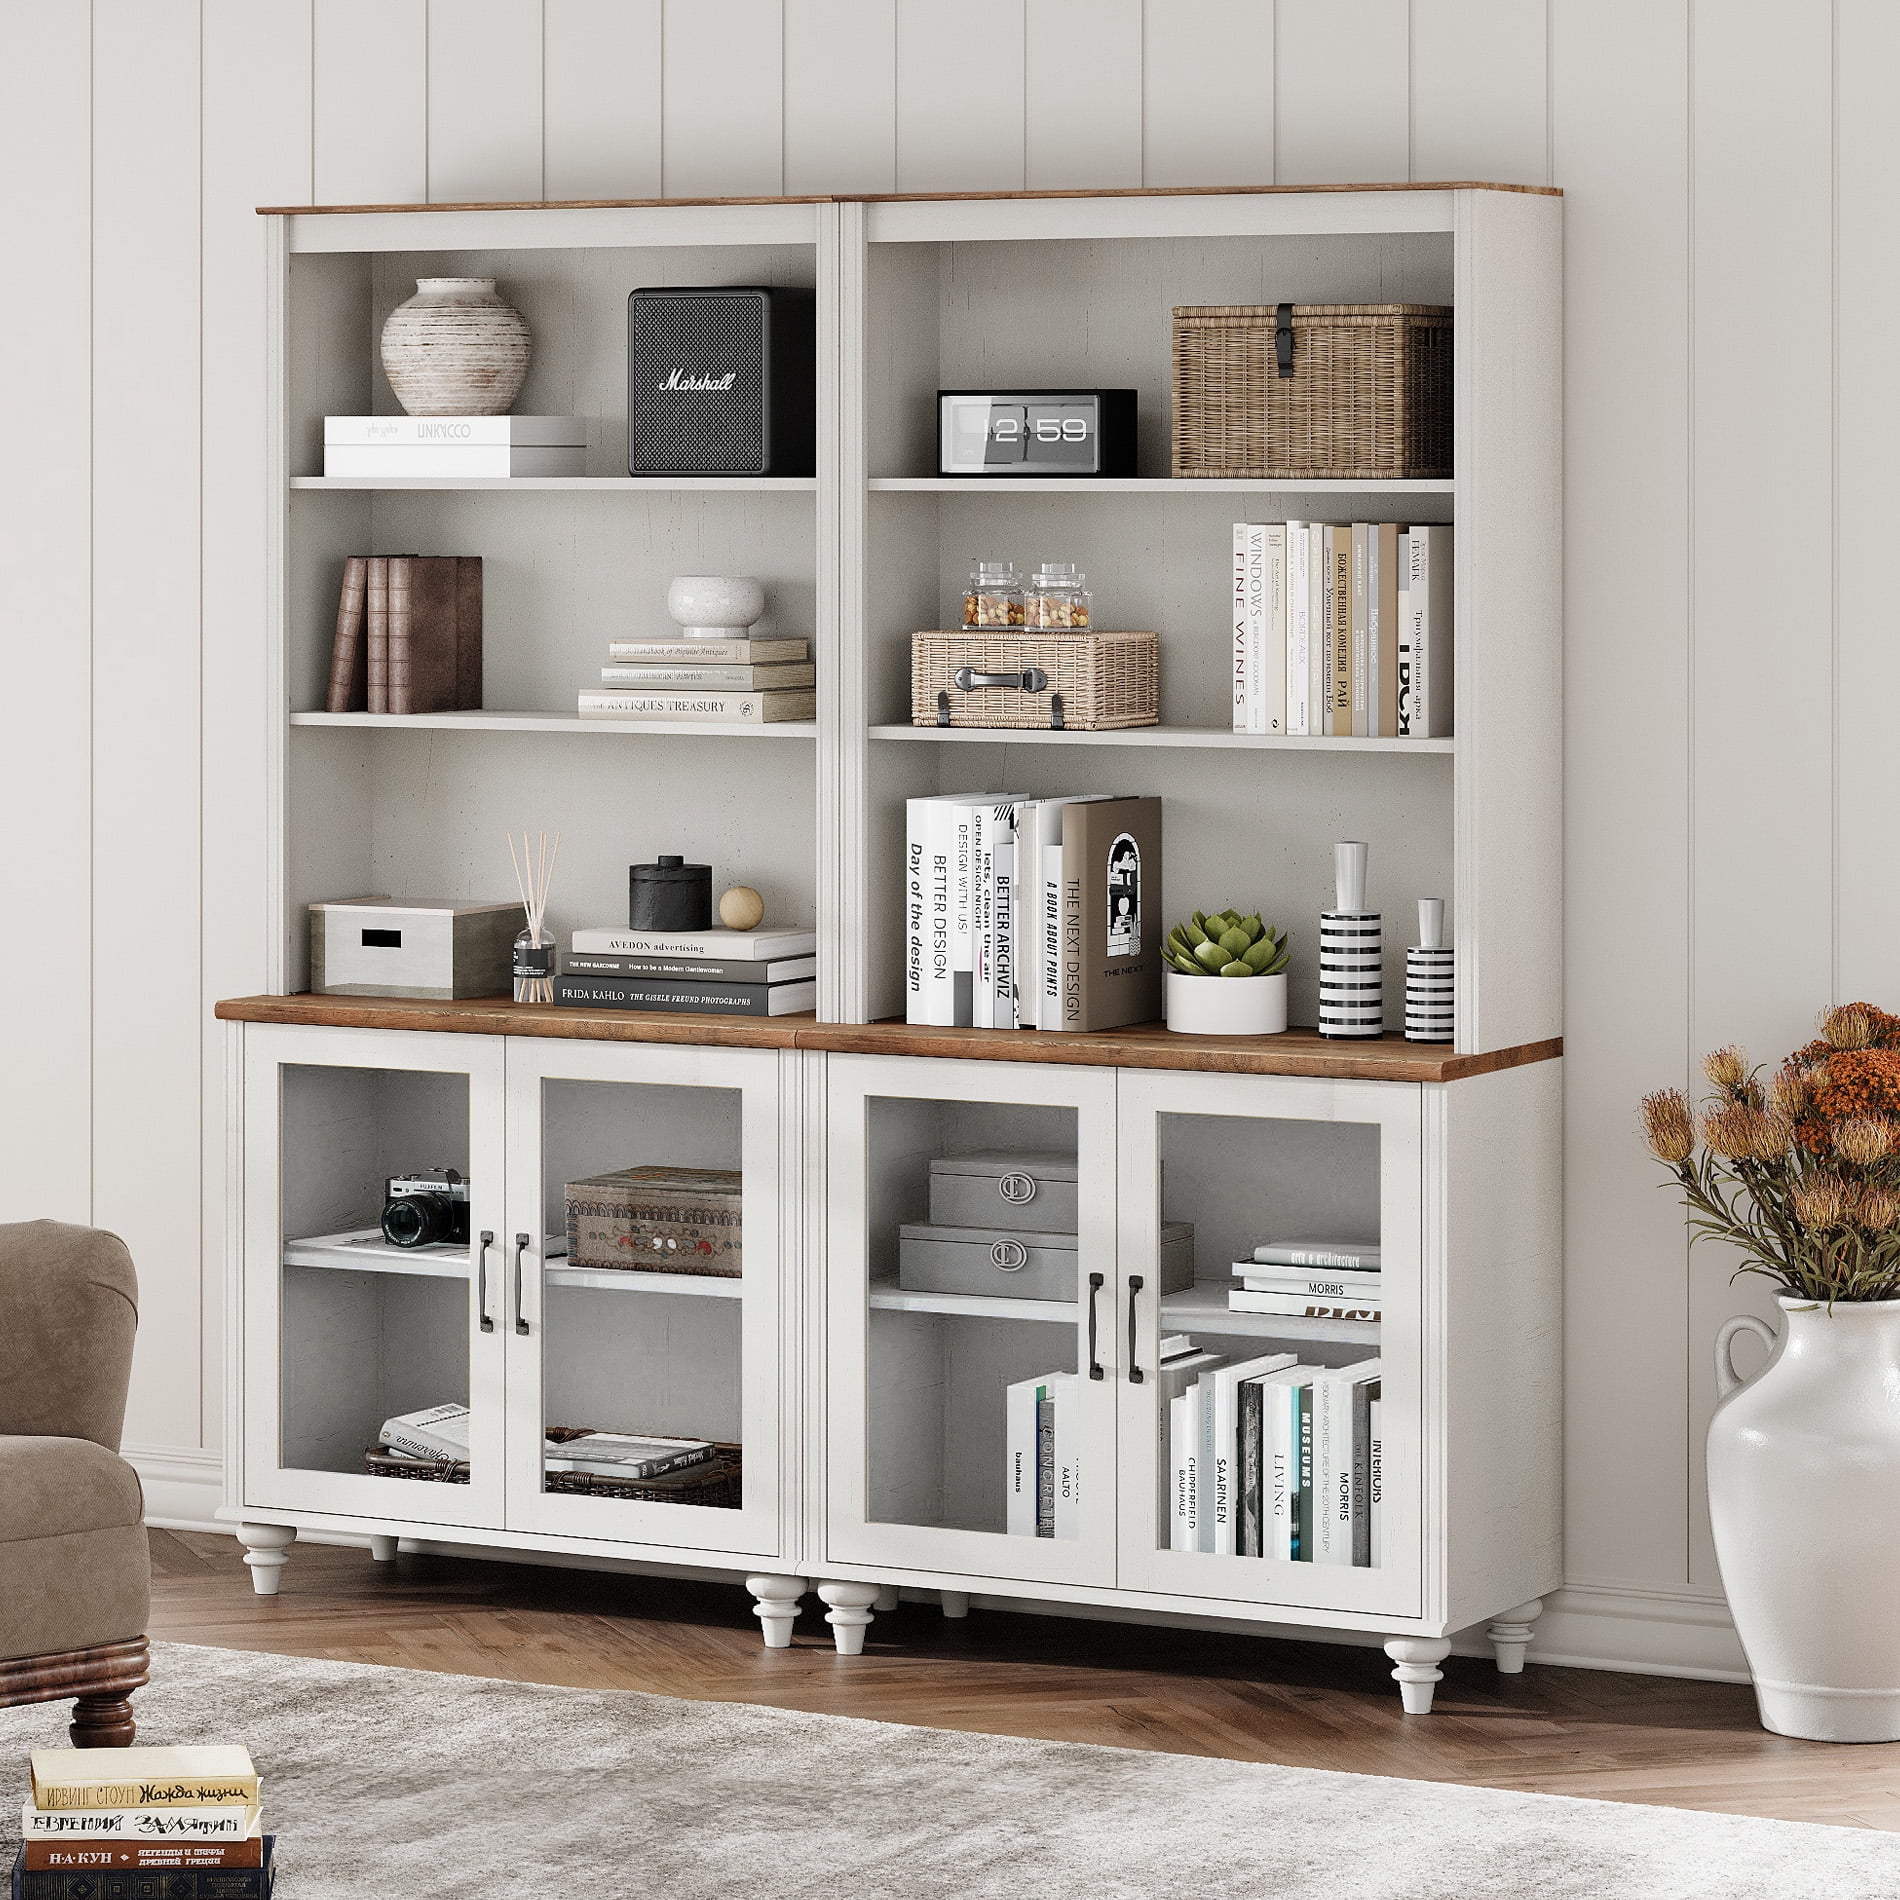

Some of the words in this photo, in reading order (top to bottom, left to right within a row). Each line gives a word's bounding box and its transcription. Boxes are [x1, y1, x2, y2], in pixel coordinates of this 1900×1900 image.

[659, 367, 736, 391] Marshall
[1036, 418, 1087, 442] 59
[1235, 553, 1245, 609] FINE
[1249, 532, 1262, 617] WINDOWS
[1337, 552, 1347, 626] БОЖЕСТВЕННАЯ
[1235, 621, 1245, 705] WINES
[1337, 628, 1347, 673] КОМЕДИЯ
[1413, 609, 1423, 691] Триумфальная
[666, 700, 725, 712] TREASURY
[1337, 680, 1350, 708] РАЙ
[1413, 695, 1421, 720] арка
[909, 843, 923, 876] Day
[958, 824, 968, 872] DESIGN
[911, 881, 923, 900] of
[933, 855, 947, 913] BETTER
[958, 876, 968, 909] WITH
[1046, 881, 1058, 889] A
[1066, 878, 1080, 909] THE
[910, 902, 923, 931] the
[983, 889, 992, 929] clean
[996, 876, 1010, 930] BETTER
[1046, 892, 1058, 920] BOOK
[608, 940, 651, 950] AVEDON
[653, 942, 705, 954] advertising
[933, 918, 947, 980] DESIGN
[983, 933, 992, 958] the
[1046, 922, 1058, 959] ABOUT
[1066, 914, 1080, 956] NEXT
[909, 935, 923, 992] design
[983, 961, 992, 983] air
[996, 933, 1010, 999] ARCHVIZ
[1046, 960, 1058, 997] POINTS
[1104, 967, 1120, 978] THE
[1121, 964, 1145, 976] NEXT
[561, 988, 590, 999] FRIDA
[592, 990, 625, 1001] KAHLO
[629, 993, 644, 1001] THE
[645, 993, 670, 1002] GISELE
[671, 995, 699, 1003] FREUND
[701, 996, 751, 1006] PHOTOGRAPHS
[1066, 962, 1080, 1021] DESIGN
[1316, 1253, 1360, 1268] architecture
[1308, 1282, 1344, 1296] MORRIS
[1301, 1412, 1311, 1488] MUSEUMS
[1015, 1451, 1023, 1494] bauhaus
[1061, 1466, 1071, 1498] AALTO
[1216, 1458, 1227, 1524] SAARINEN
[1273, 1454, 1284, 1517] LIVING
[1322, 1468, 1329, 1478] OF
[1354, 1462, 1363, 1519] KINFOLK
[1178, 1468, 1186, 1517] BAUHAUS
[1188, 1456, 1196, 1530] CHIPPERFIELD
[1339, 1472, 1349, 1522] MORRIS
[46, 1786, 93, 1807] ИРВИНГ
[96, 1785, 135, 1805] СТОУН
[139, 1784, 194, 1804] Жажда
[196, 1786, 249, 1802] жизни
[30, 1814, 125, 1832] ЕВГЕНИЙ
[133, 1814, 238, 1835] ЗАМЯТИН
